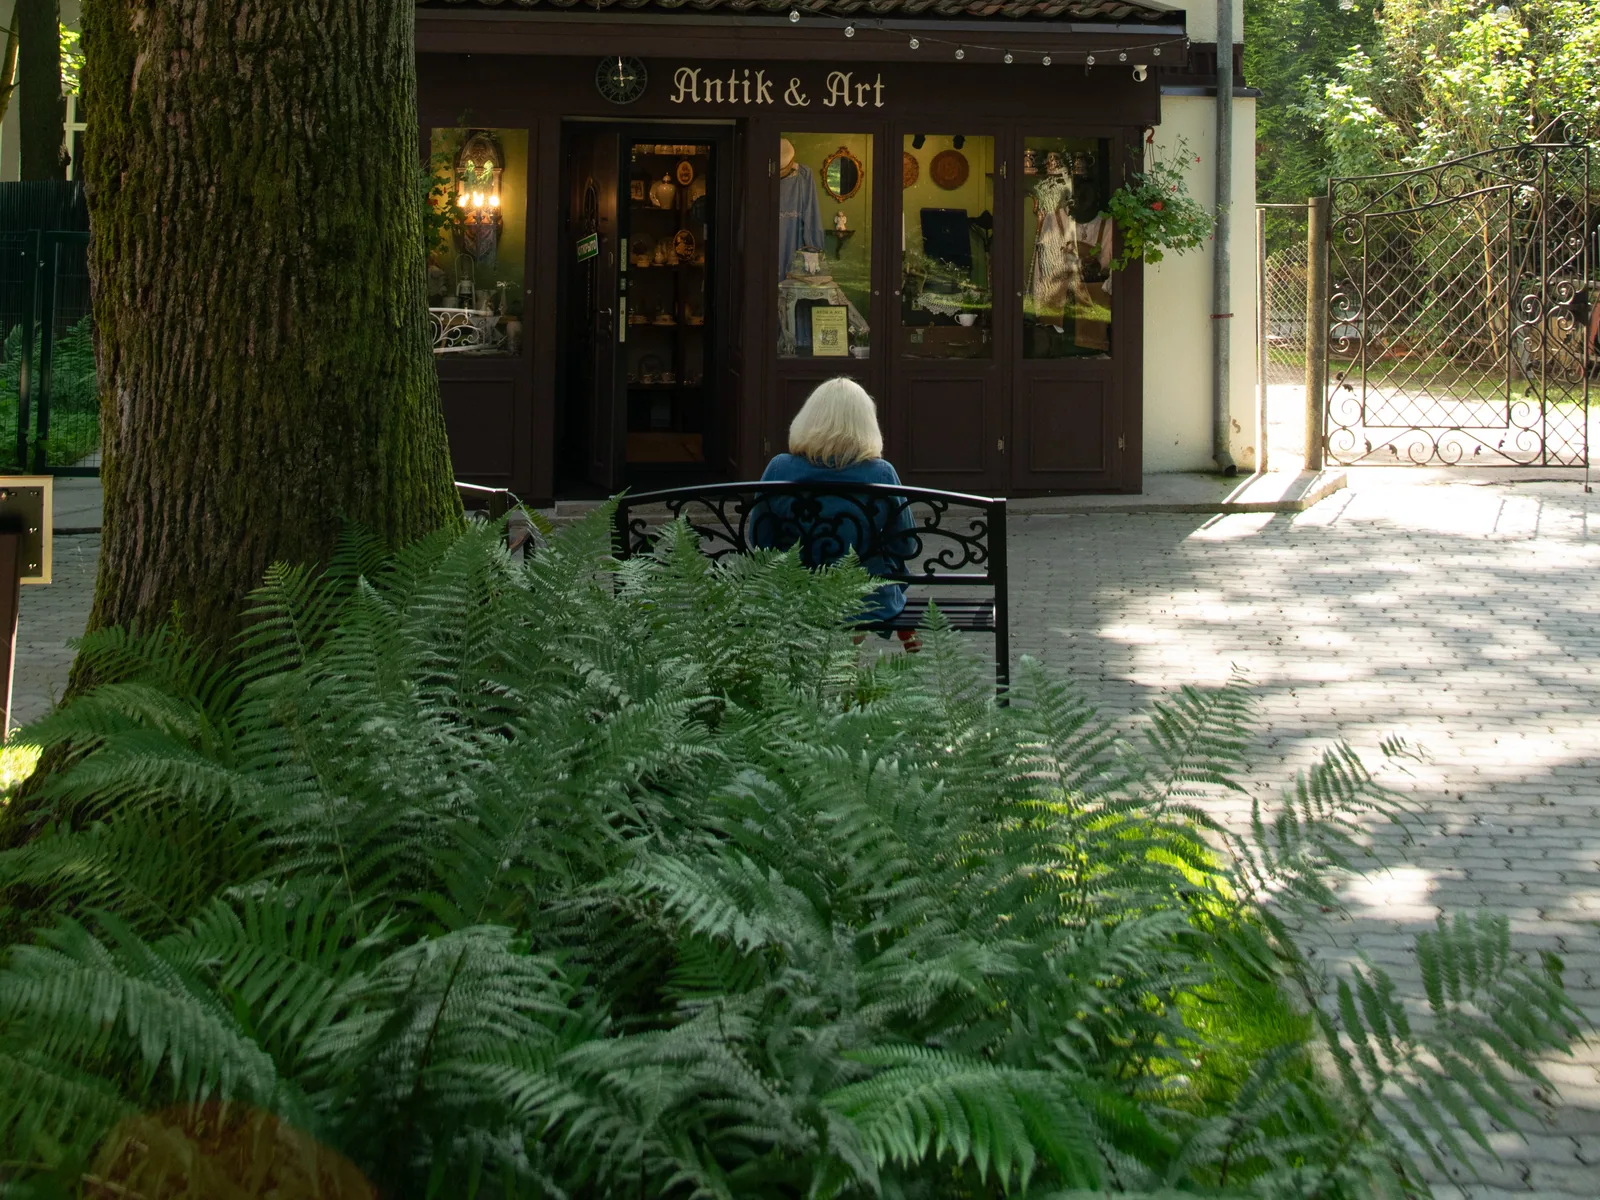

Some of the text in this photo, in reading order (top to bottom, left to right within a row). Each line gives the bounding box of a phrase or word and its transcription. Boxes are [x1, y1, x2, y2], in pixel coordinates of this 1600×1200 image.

[670, 66, 774, 105] Antik
[783, 77, 811, 107] &
[822, 71, 886, 108] Art
